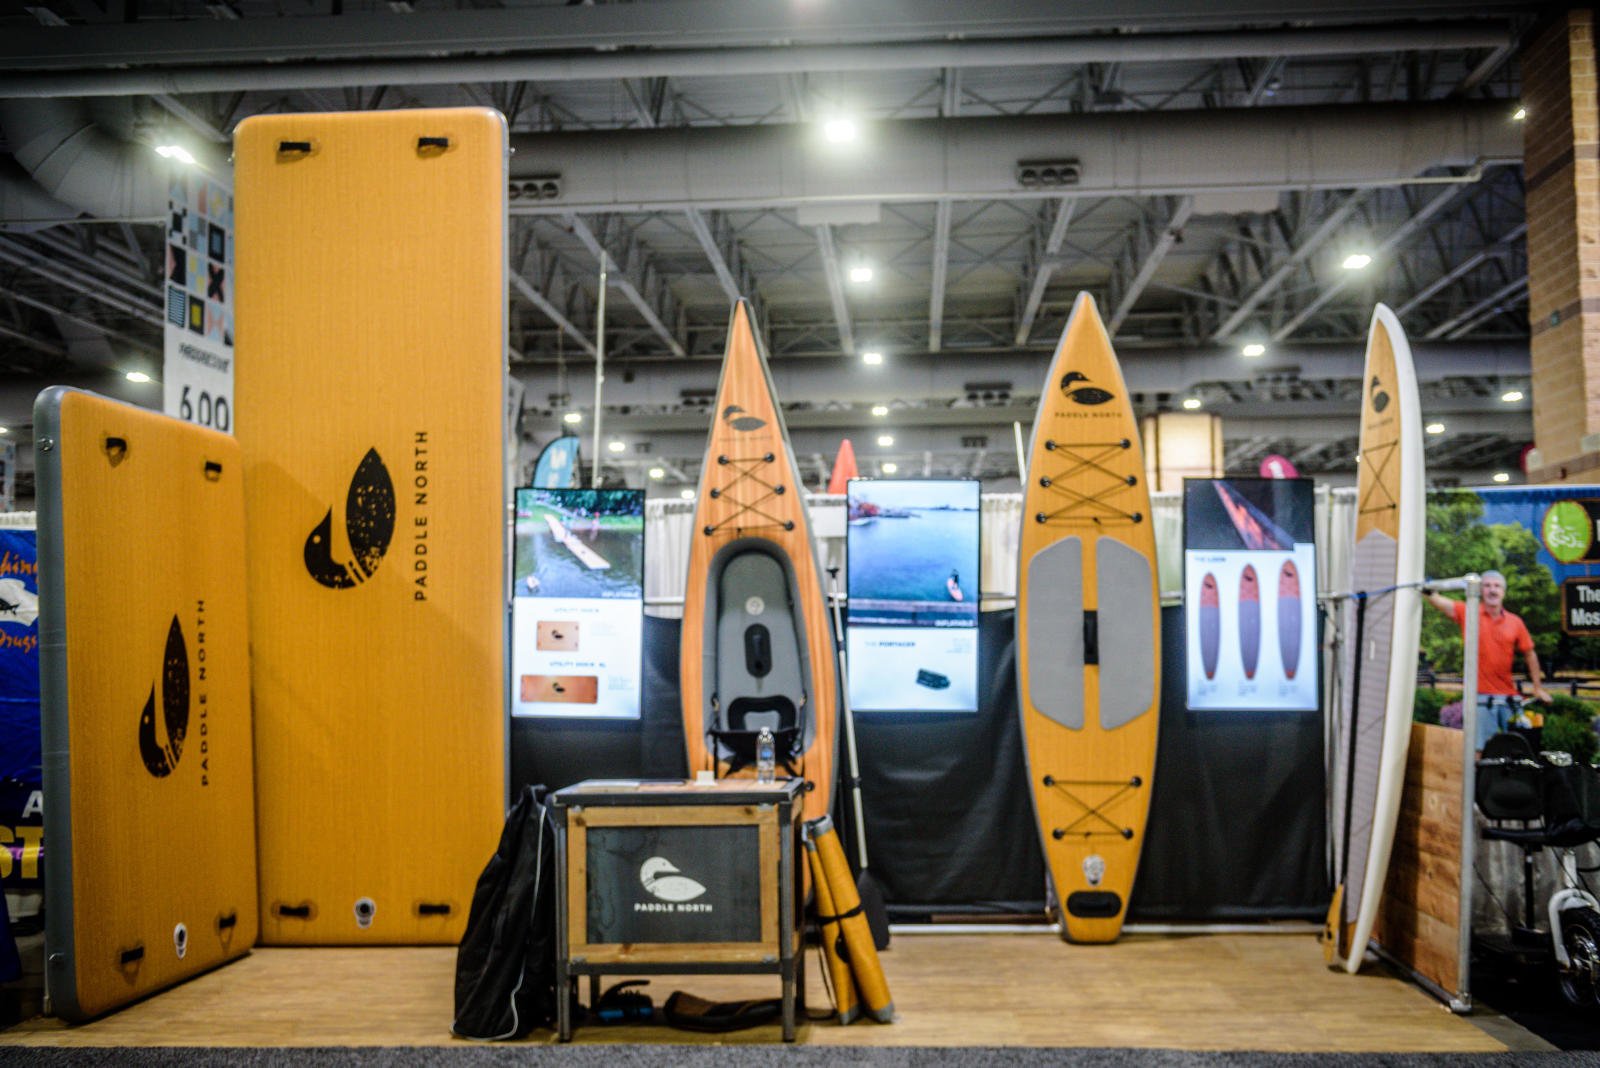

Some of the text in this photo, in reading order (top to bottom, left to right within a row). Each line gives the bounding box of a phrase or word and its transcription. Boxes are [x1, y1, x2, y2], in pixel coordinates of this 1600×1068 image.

[181, 386, 229, 431] 600
[414, 432, 428, 601] PADDLE NORTH
[197, 600, 209, 786] PADDLE NORTH
[634, 902, 712, 912] PADDLE NORTH
